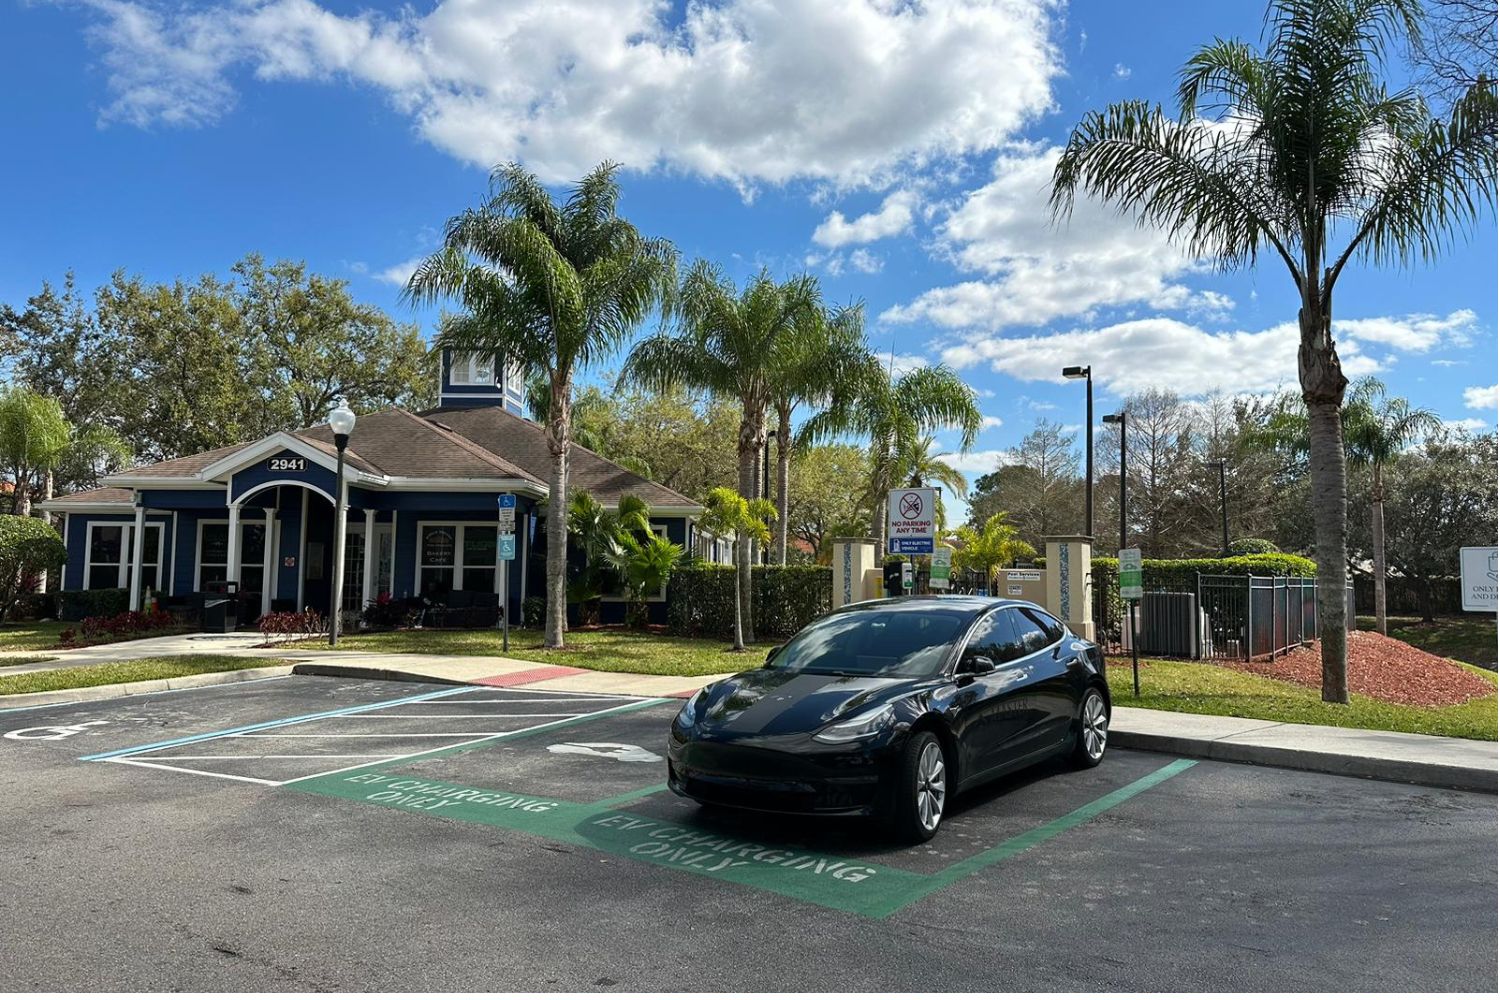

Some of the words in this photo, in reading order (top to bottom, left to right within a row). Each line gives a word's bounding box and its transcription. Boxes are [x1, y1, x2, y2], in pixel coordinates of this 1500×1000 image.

[270, 459, 305, 470] 2941
[343, 773, 399, 785] EV
[387, 780, 559, 812] CHARGING
[366, 791, 462, 810] ONLY
[592, 815, 655, 831] EV
[649, 827, 877, 883] CHARGING
[630, 841, 749, 872] ONLY
